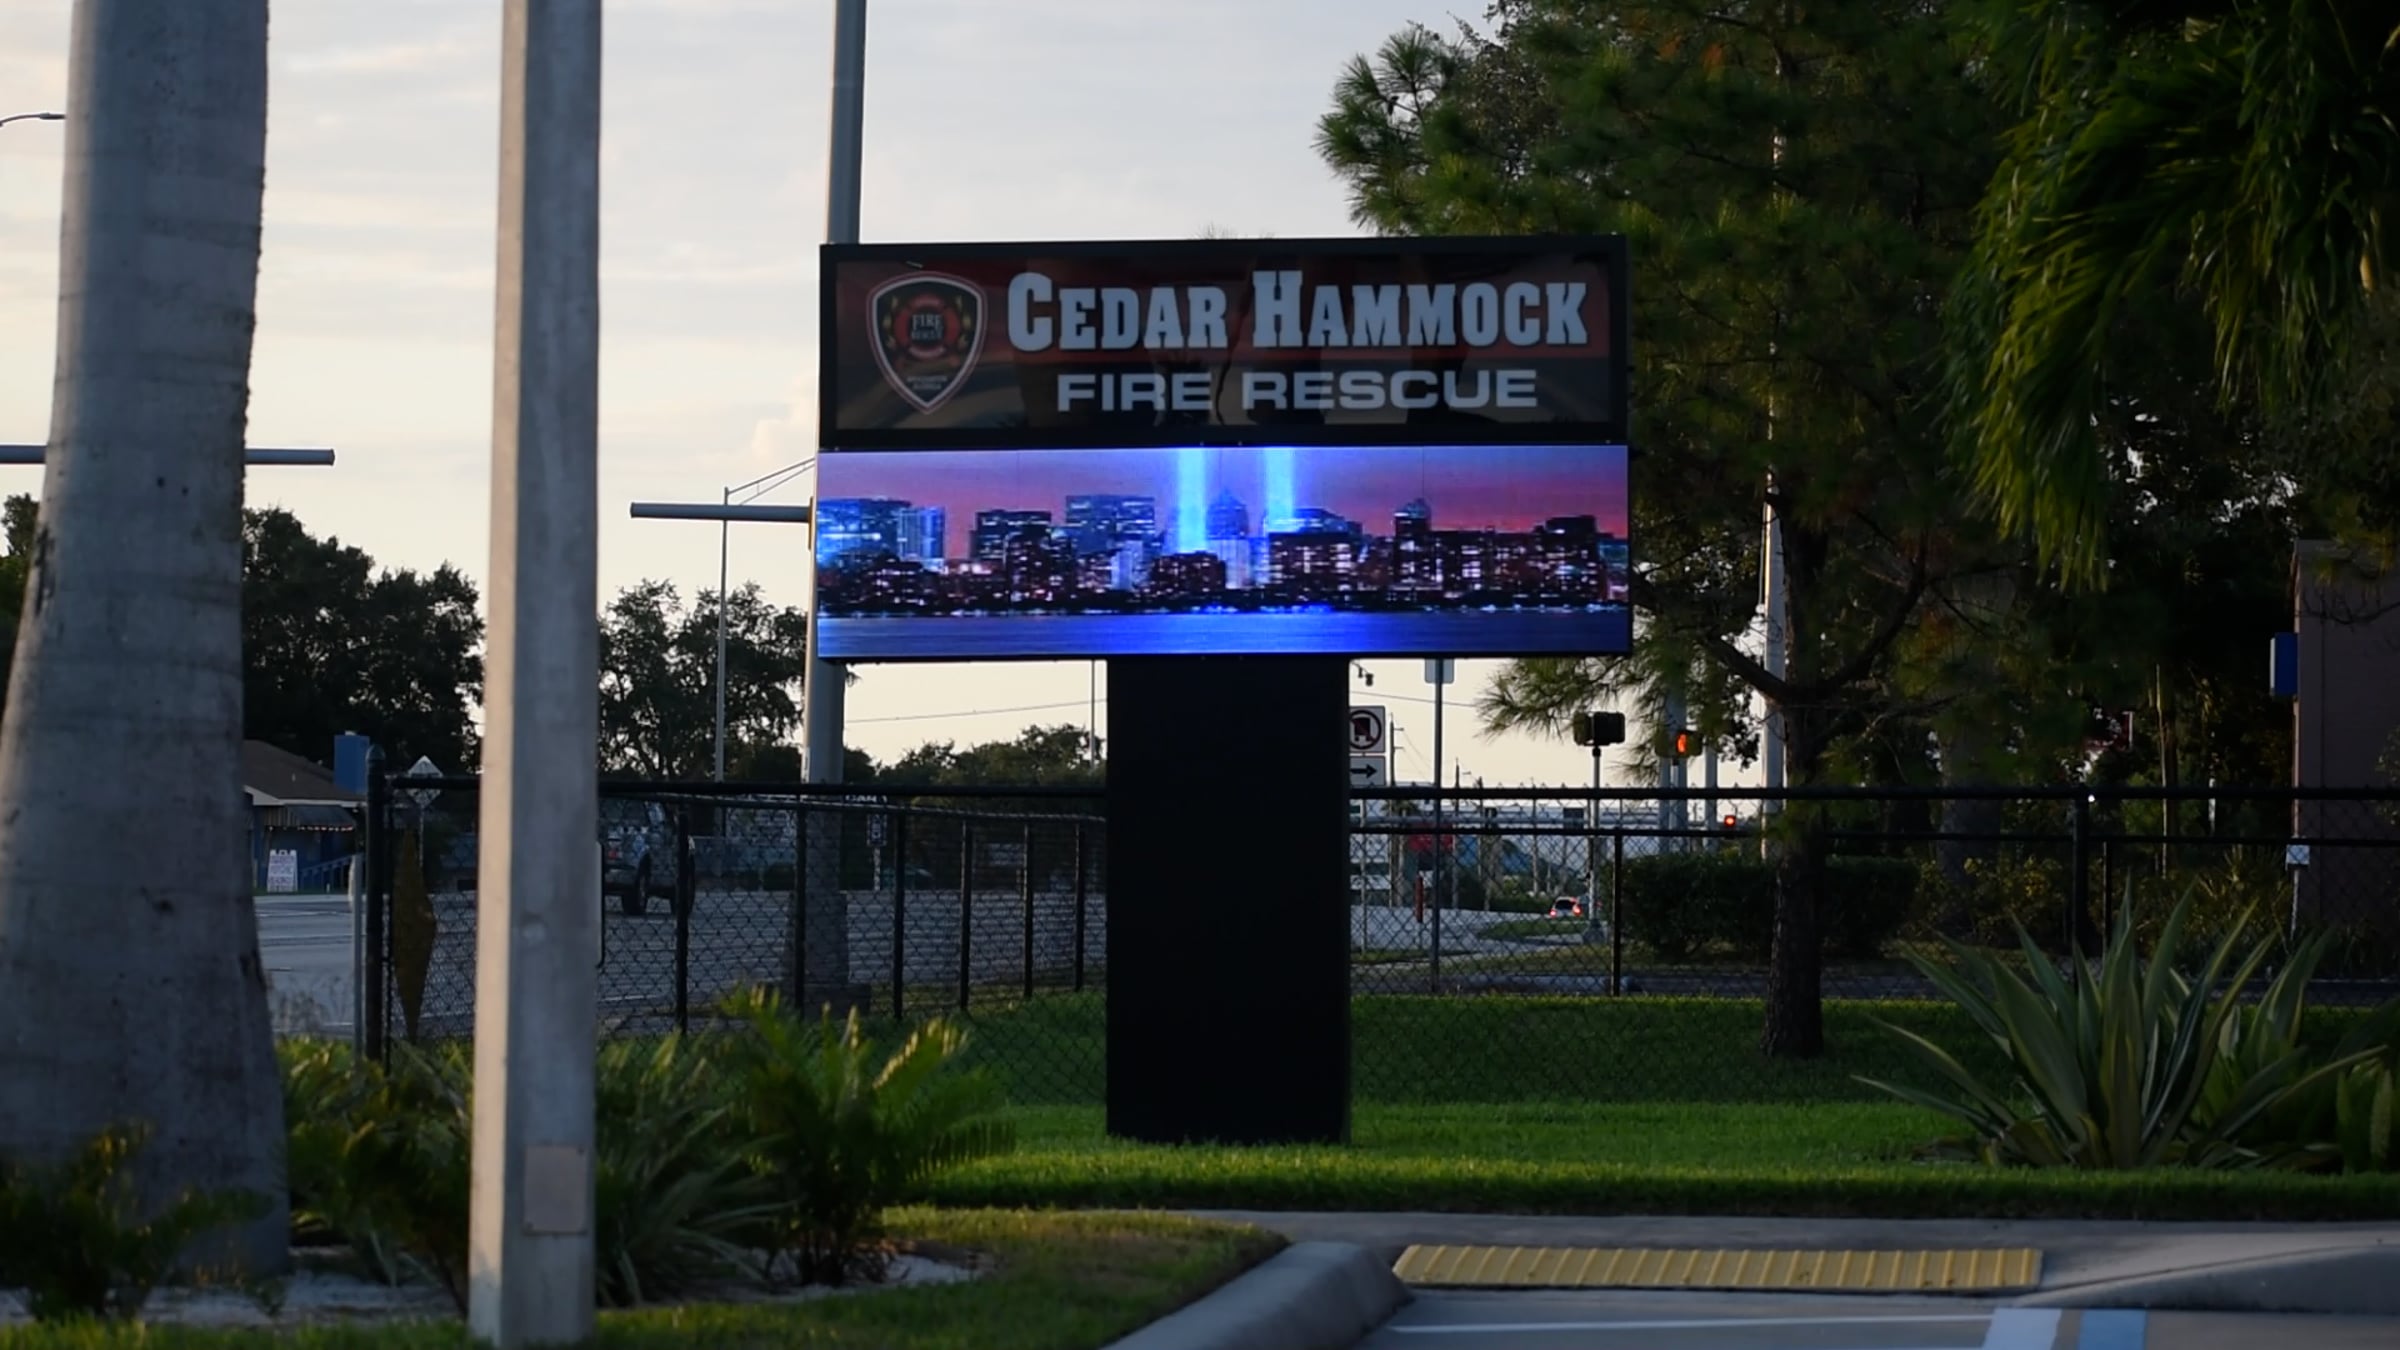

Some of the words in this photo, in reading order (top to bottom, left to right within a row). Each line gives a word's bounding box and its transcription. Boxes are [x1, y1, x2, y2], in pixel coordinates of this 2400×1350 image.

[912, 314, 942, 329] FIRE
[1008, 272, 1227, 351] CEDAR
[1253, 270, 1588, 348] HAMMOCK
[1058, 373, 1212, 412] FIRE
[1242, 370, 1538, 410] RESCUE
